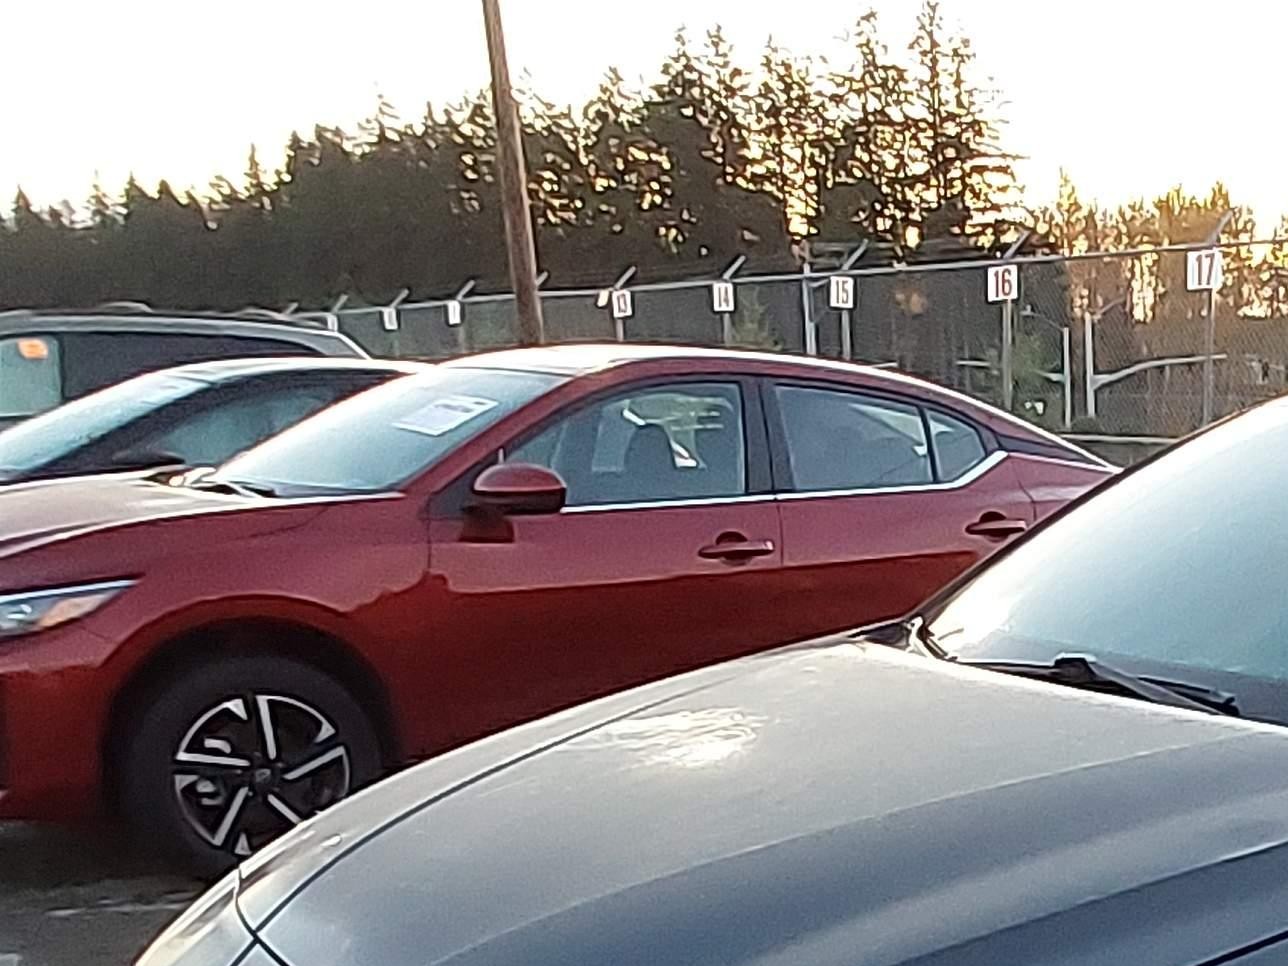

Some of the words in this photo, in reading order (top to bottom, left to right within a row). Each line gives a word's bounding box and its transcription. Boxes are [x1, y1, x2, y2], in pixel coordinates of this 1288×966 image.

[994, 268, 1013, 298] 16
[1195, 253, 1216, 286] 17
[835, 279, 849, 304] 15
